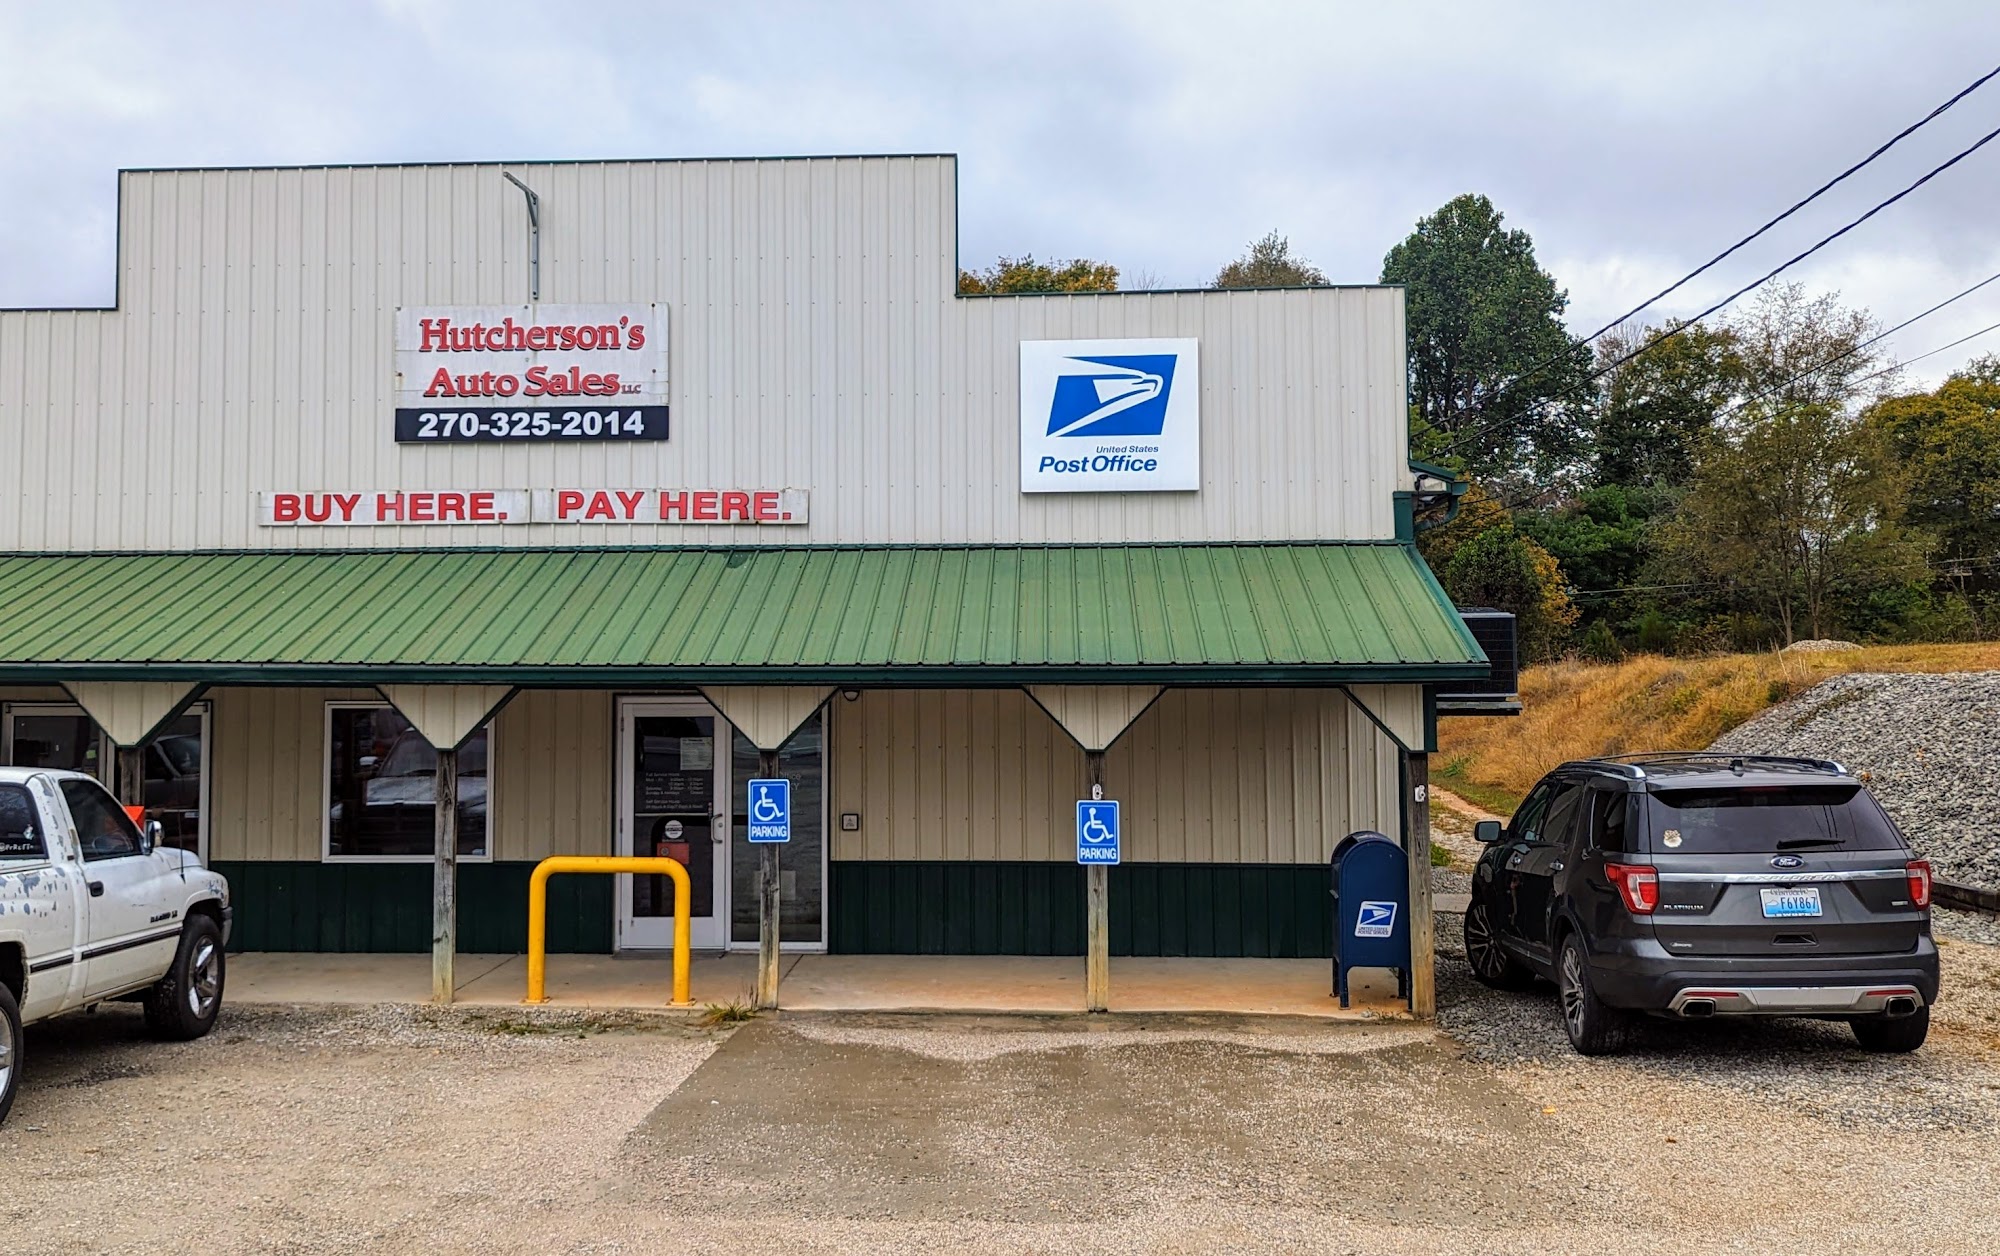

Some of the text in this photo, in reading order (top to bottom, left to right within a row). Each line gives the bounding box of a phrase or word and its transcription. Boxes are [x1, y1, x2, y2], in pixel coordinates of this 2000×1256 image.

[419, 316, 646, 352] Hutcherson's
[423, 366, 642, 398] Auto Sales LLC
[417, 410, 645, 437] 270-325-2014
[1128, 445, 1159, 453] States
[1039, 455, 1158, 473] Post Office
[273, 492, 508, 522] BUY HERE.
[558, 491, 792, 520] PAY HERE.
[751, 826, 787, 838] PARKING
[1080, 847, 1117, 860] PARKING
[1778, 858, 1798, 867] Ford
[1780, 897, 1817, 911] F6Y867
